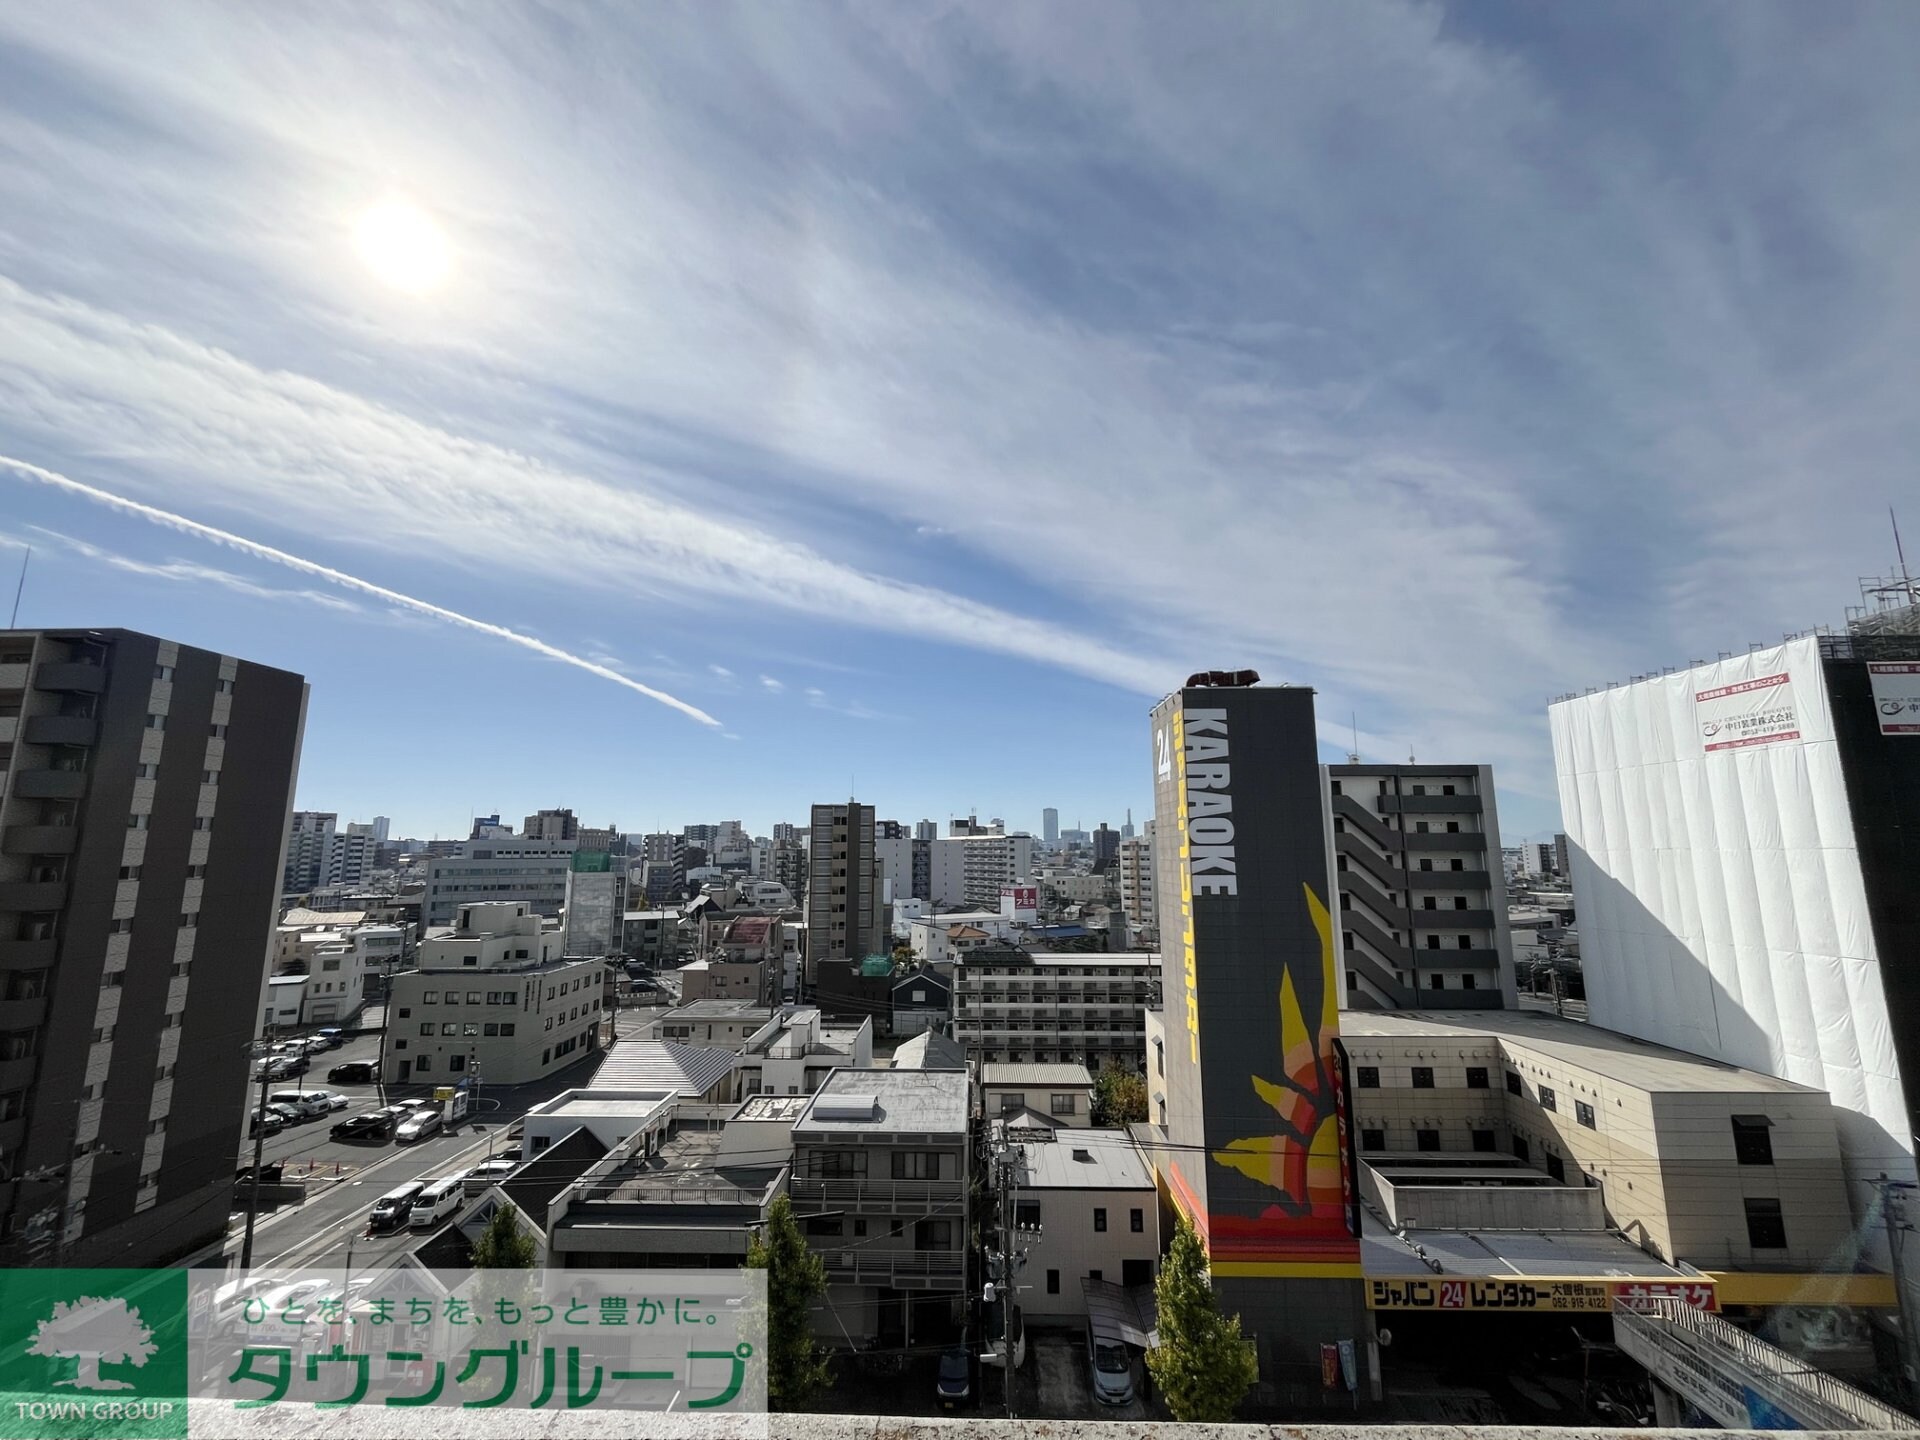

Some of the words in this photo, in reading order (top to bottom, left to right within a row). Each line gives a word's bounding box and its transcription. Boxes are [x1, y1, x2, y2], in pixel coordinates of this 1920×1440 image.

[1156, 722, 1171, 780] 24
[1183, 707, 1238, 897] KARAOKE
[1373, 1280, 1435, 1306] ジャパン
[1441, 1282, 1465, 1308] 24
[1470, 1282, 1551, 1307] レンタカー
